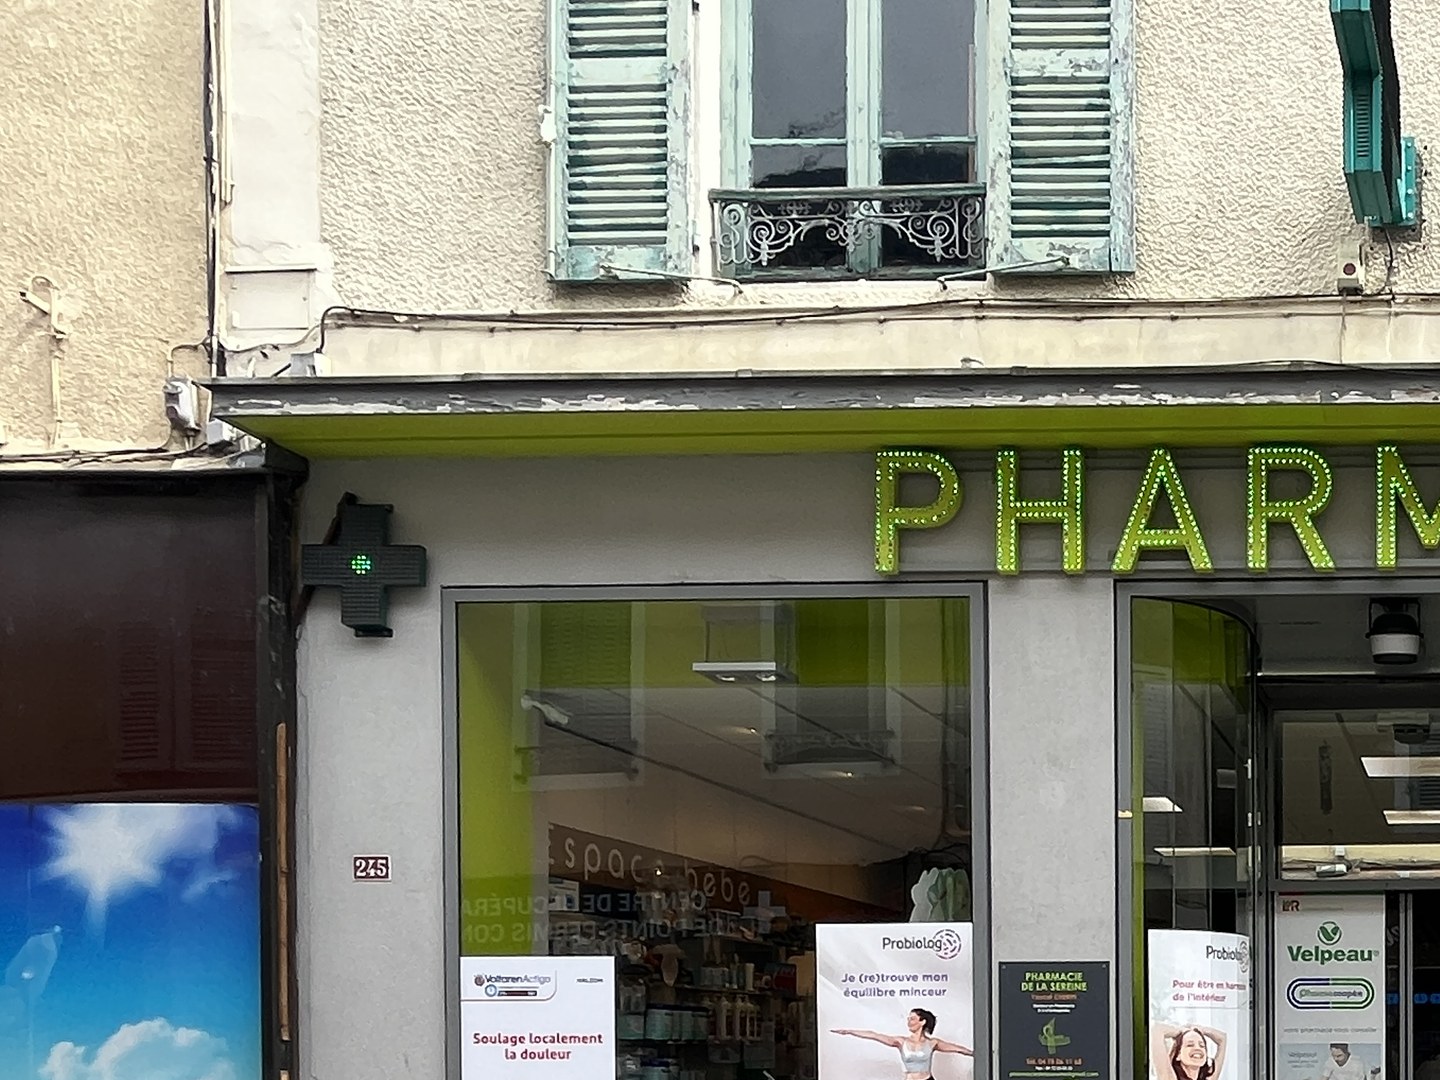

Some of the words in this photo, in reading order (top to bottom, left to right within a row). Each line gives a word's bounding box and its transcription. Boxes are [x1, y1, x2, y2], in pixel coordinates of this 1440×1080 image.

[355, 858, 388, 877] 245
[882, 936, 942, 952] Probiolog
[841, 973, 855, 983] Je
[859, 973, 919, 984] (re)trouve
[922, 974, 948, 982] mon
[1025, 972, 1083, 981] PHARMACIE
[1021, 982, 1034, 991] DE
[1036, 982, 1048, 991] LA
[1172, 980, 1195, 989] Pour
[843, 987, 896, 998] équilibre
[900, 987, 947, 997] minceur
[473, 1033, 526, 1046] Soulage
[529, 1033, 603, 1044] localement
[505, 1048, 516, 1060] la
[521, 1048, 571, 1060] douleur
